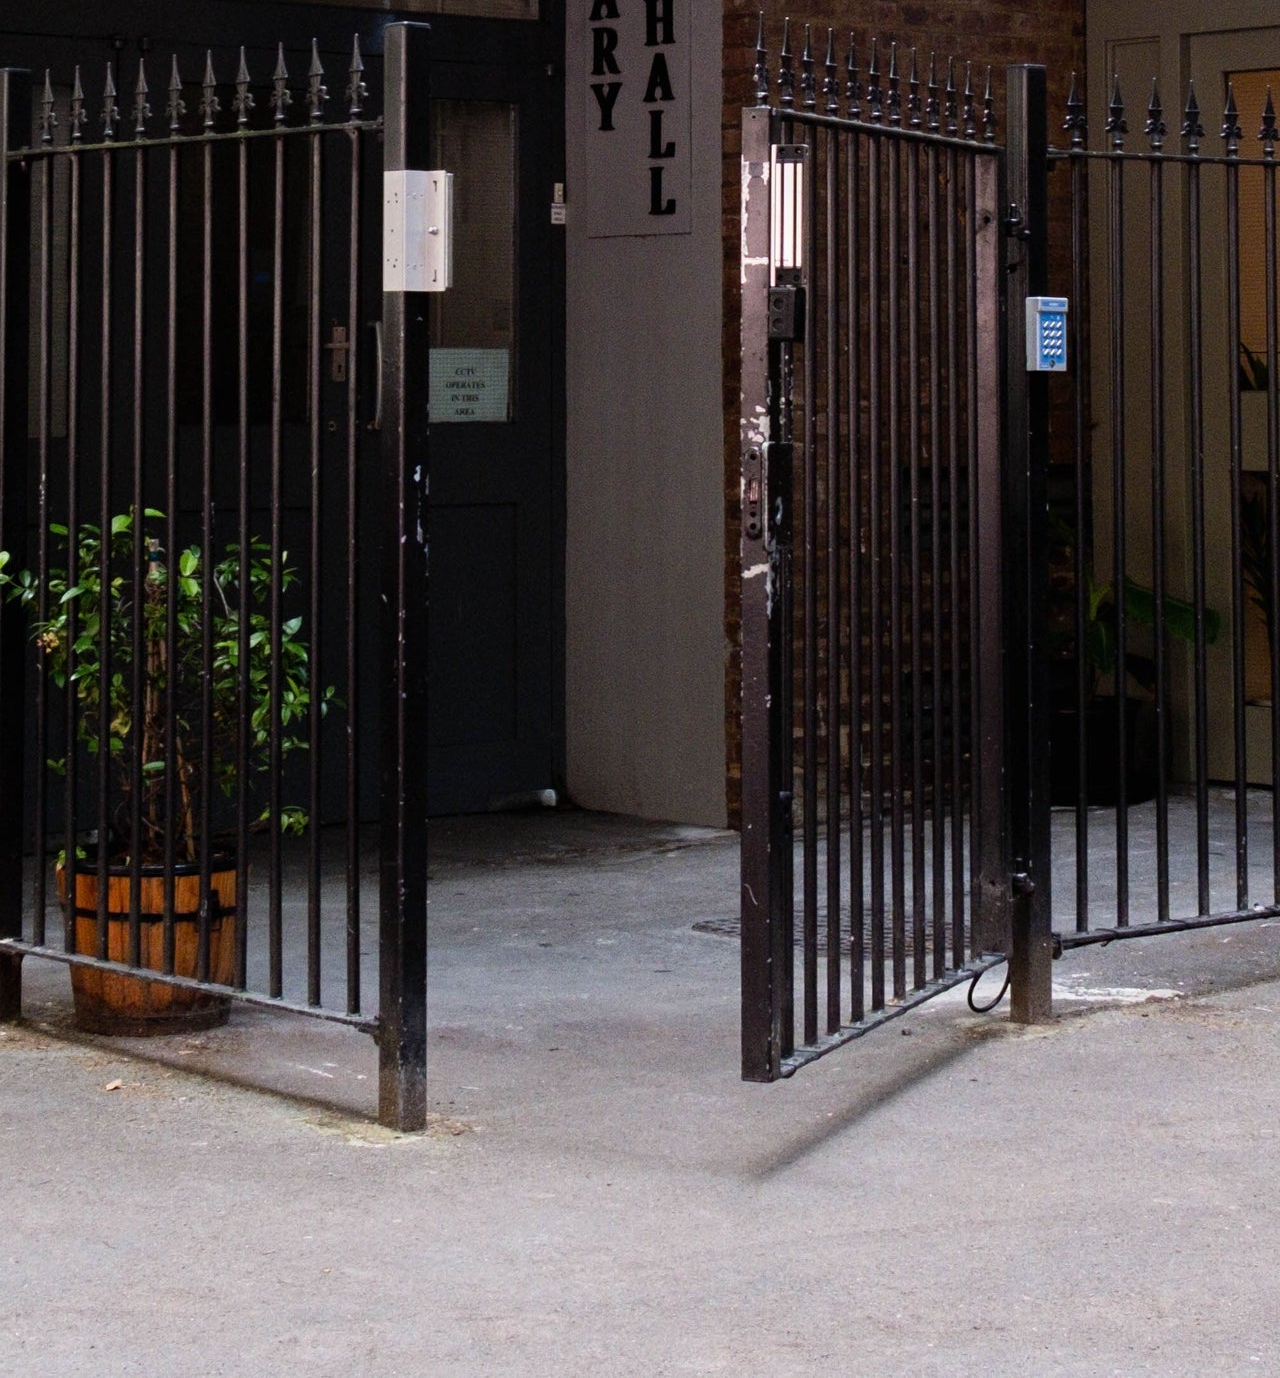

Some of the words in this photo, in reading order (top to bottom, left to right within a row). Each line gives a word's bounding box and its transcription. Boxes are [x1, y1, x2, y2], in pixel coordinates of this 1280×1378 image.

[455, 367, 476, 376] CCTV
[445, 380, 486, 389] OPERATES
[451, 394, 460, 402] IN
[461, 394, 479, 402] THIS
[455, 407, 475, 416] AREA
